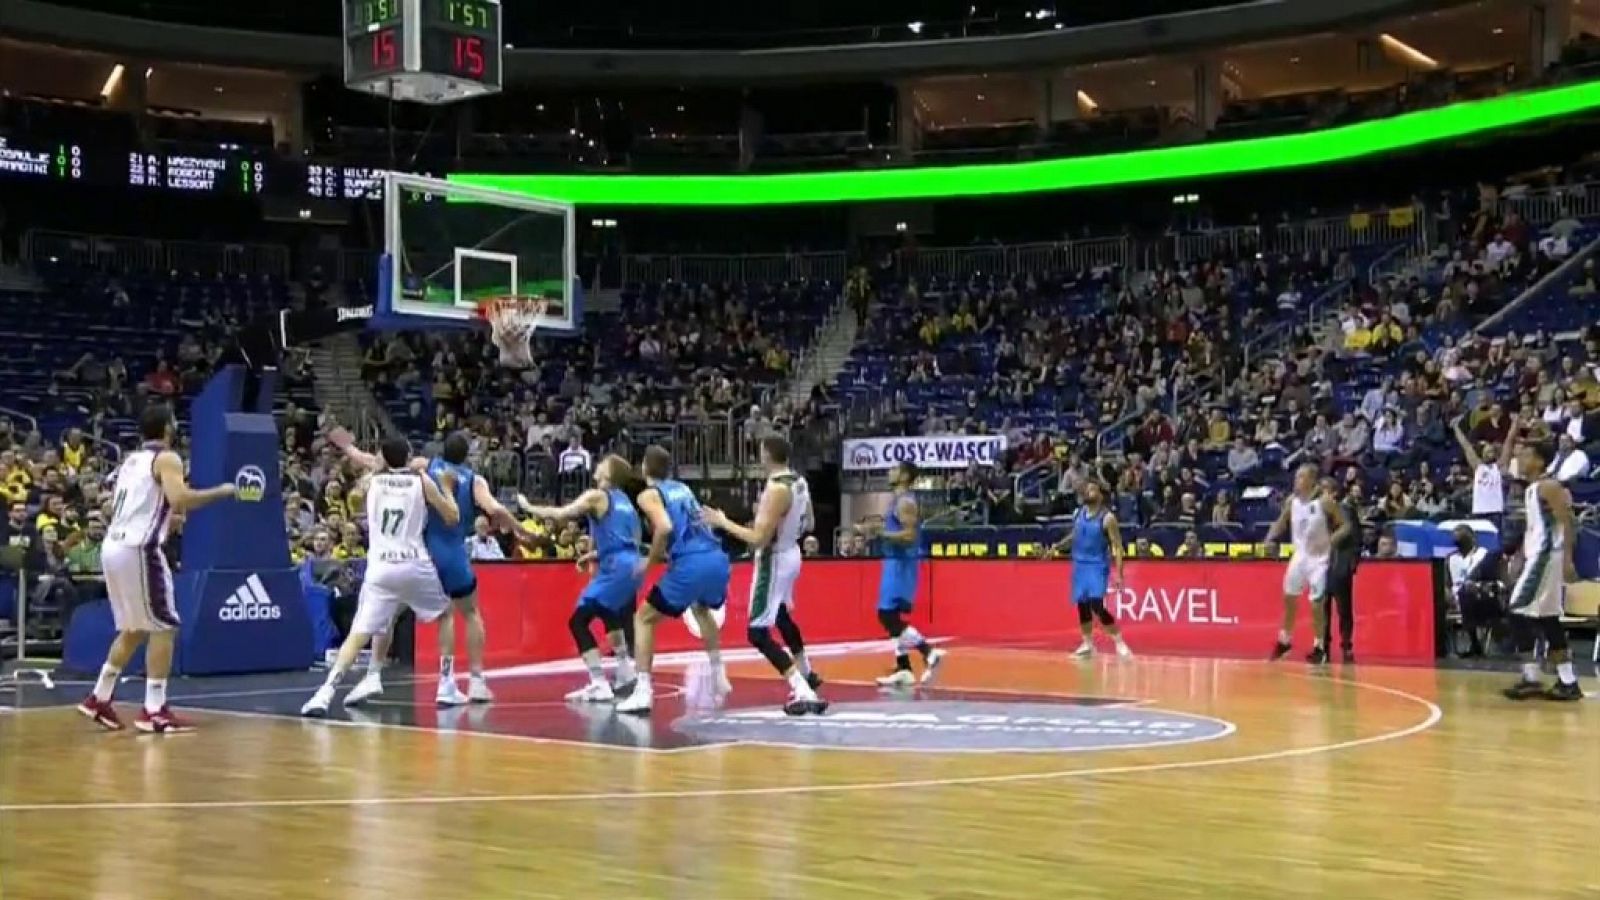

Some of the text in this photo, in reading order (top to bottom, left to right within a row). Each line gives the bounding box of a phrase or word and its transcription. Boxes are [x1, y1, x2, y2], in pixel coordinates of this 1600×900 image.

[372, 30, 396, 67] 15
[454, 37, 485, 75] 15
[381, 508, 405, 535] 17
[218, 603, 281, 620] adidas
